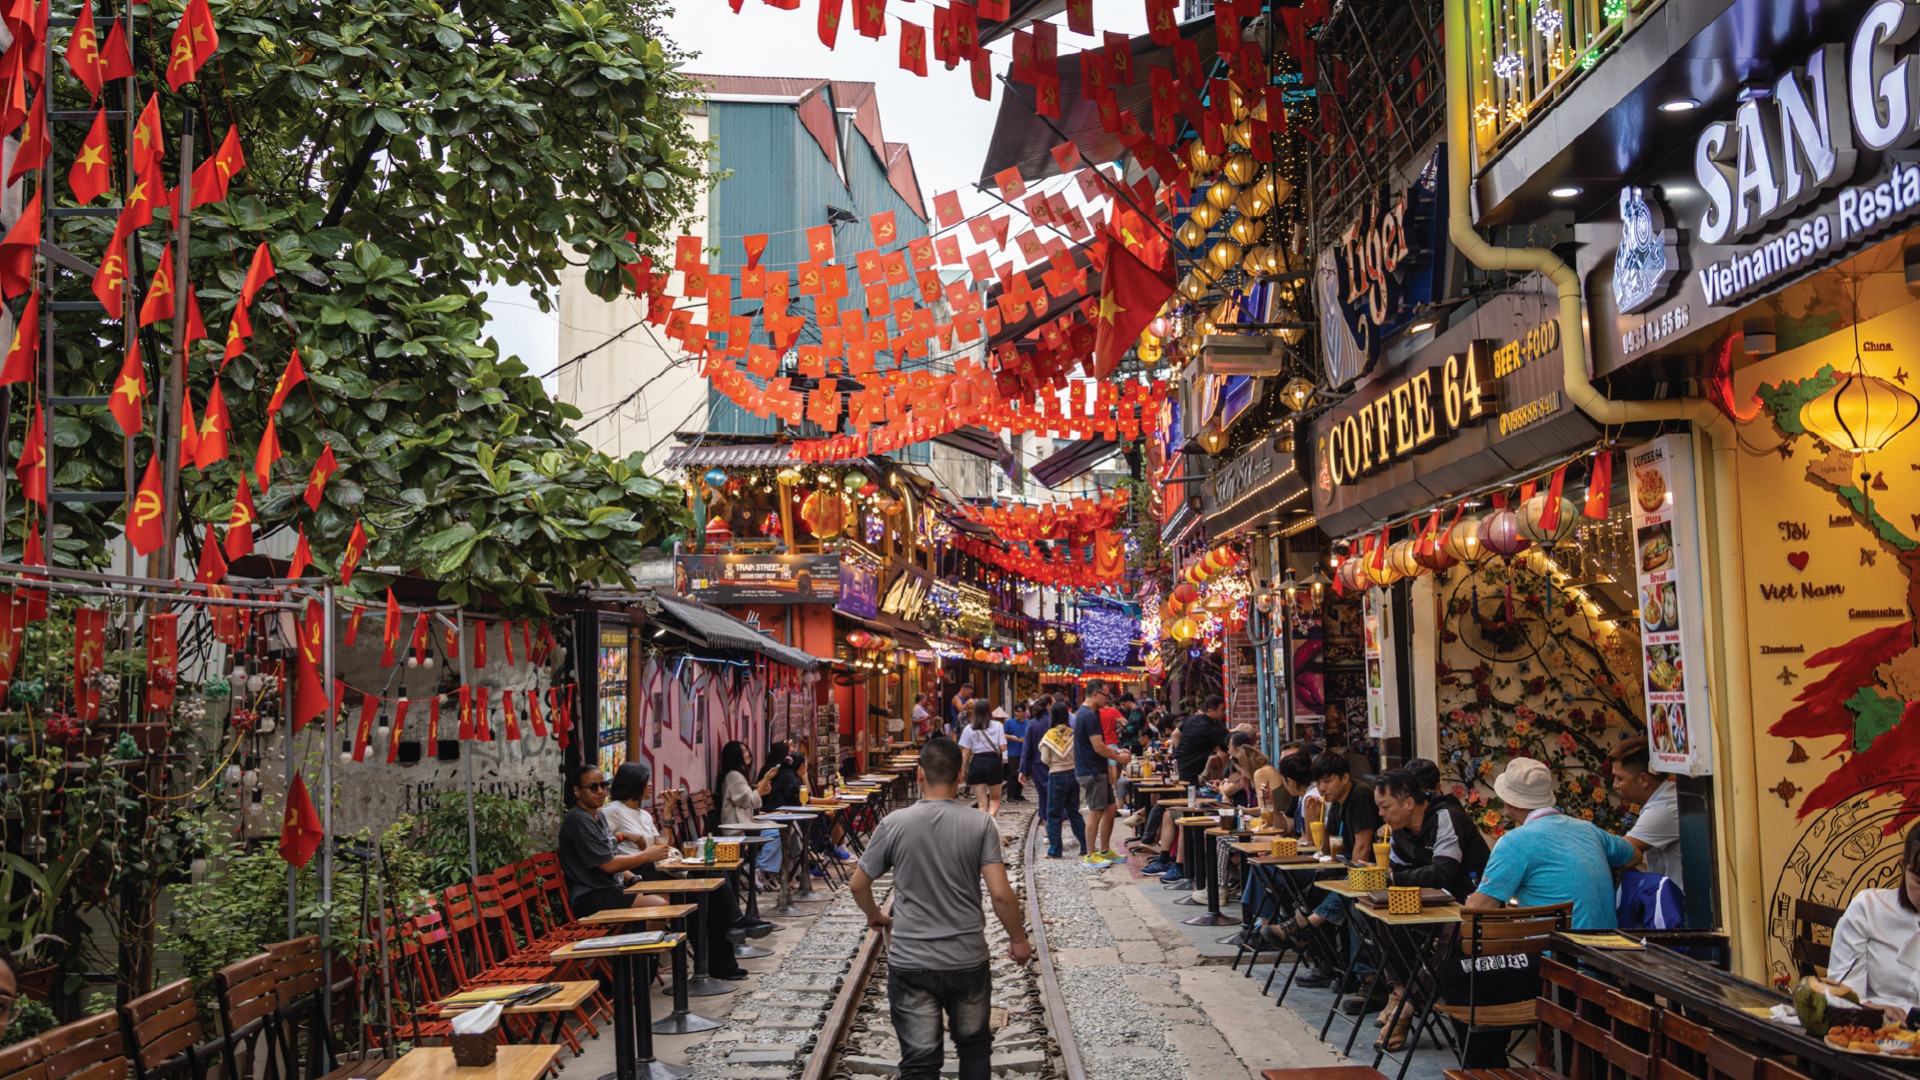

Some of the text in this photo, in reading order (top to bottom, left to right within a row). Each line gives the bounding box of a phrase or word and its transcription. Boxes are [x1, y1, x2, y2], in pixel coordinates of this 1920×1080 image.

[1851, 0, 1920, 150] G
[1341, 186, 1409, 325] Tiger
[1699, 214, 1831, 306] Vietnamese
[1863, 340, 1893, 351] China
[1328, 369, 1436, 486] COFFEE
[1442, 342, 1483, 430] 64
[1645, 514, 1662, 525] Pizza
[1829, 514, 1854, 524] Laos
[735, 563, 780, 572] TRAIN STREET
[1650, 571, 1667, 583] Bread
[1801, 582, 1845, 599] Nam
[1849, 607, 1905, 618] Campuchia
[1658, 753, 1687, 763] Vegetarian
